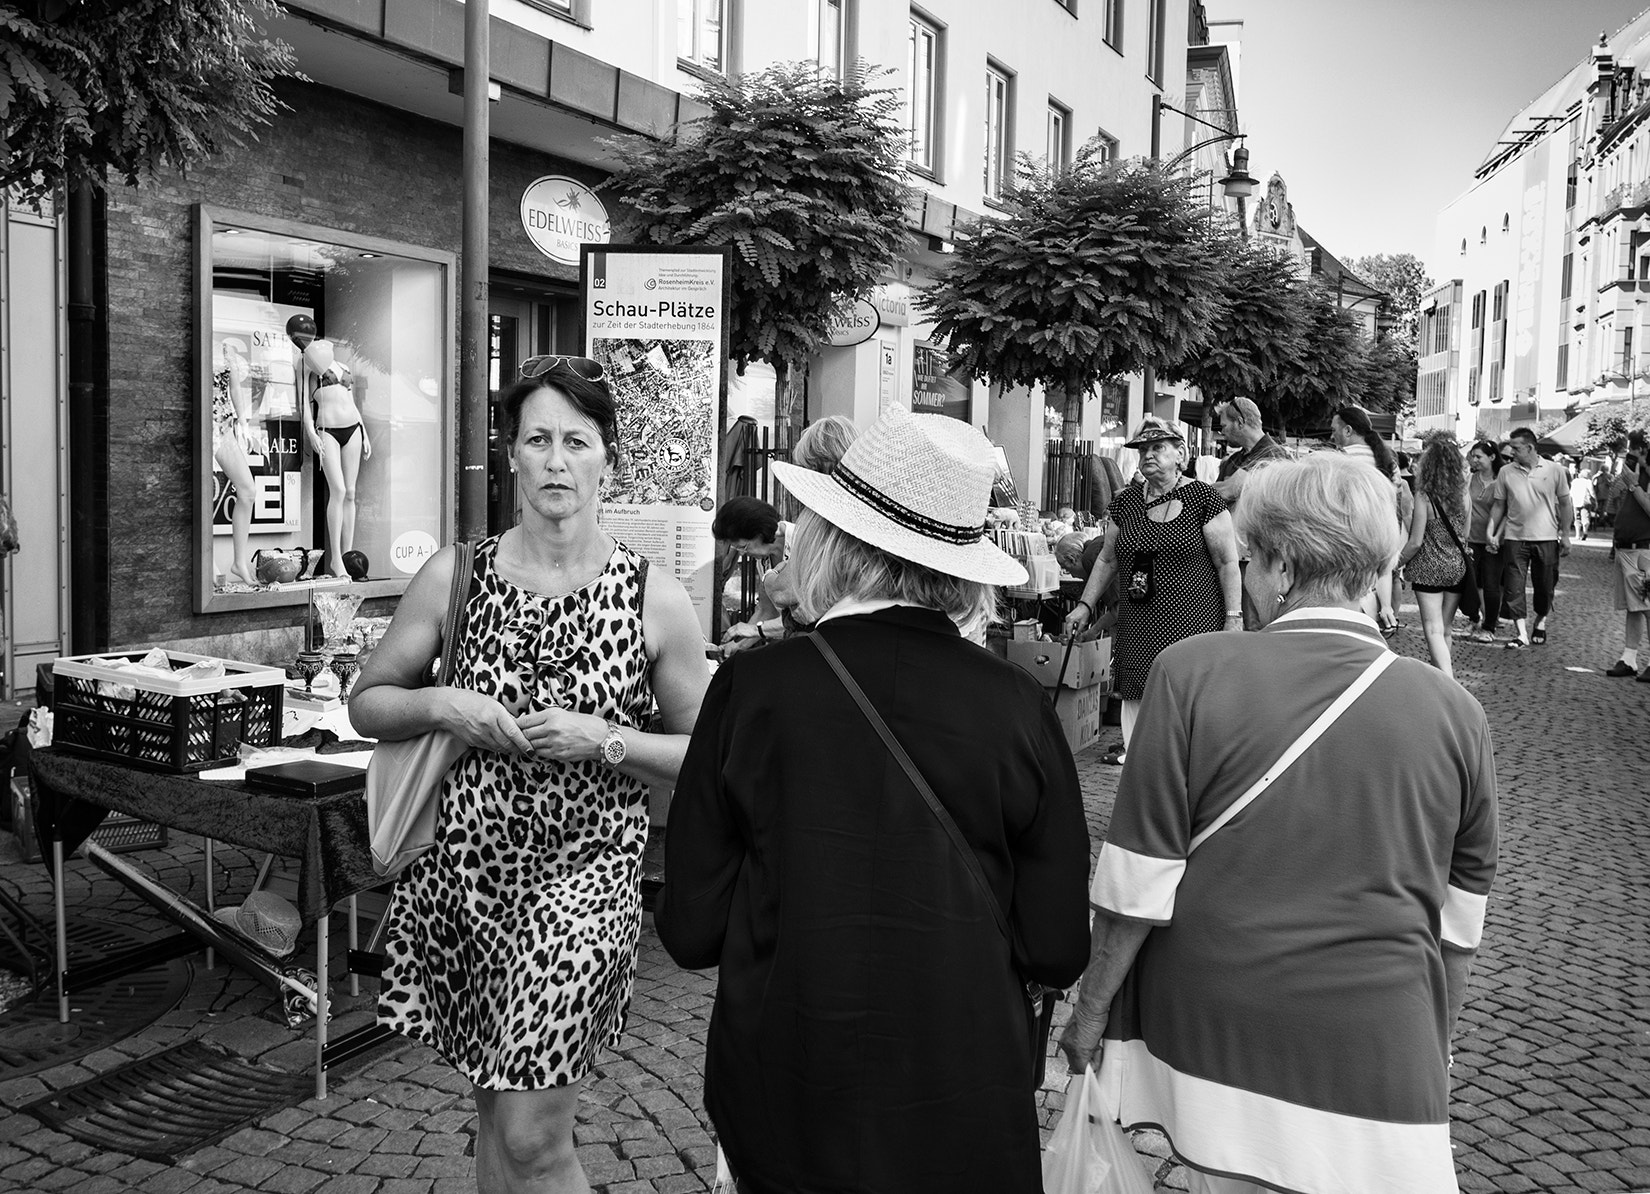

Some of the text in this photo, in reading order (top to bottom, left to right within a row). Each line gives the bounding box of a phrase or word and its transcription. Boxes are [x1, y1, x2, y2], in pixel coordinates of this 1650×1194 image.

[528, 208, 602, 243] EDELWEISS
[556, 239, 579, 252] BASICS
[594, 278, 606, 288] 02
[658, 278, 704, 286] RosenheimKreis
[593, 300, 715, 318] Schau-Plätze
[607, 320, 622, 329] Zeit
[623, 321, 637, 329] der
[638, 321, 696, 332] Stadterhebung
[697, 322, 715, 331] 1864
[833, 315, 871, 329] WEISS
[885, 352, 893, 366] 1a
[912, 390, 946, 408] SOMMER?
[262, 438, 298, 454] SALE
[395, 545, 414, 559] CUP
